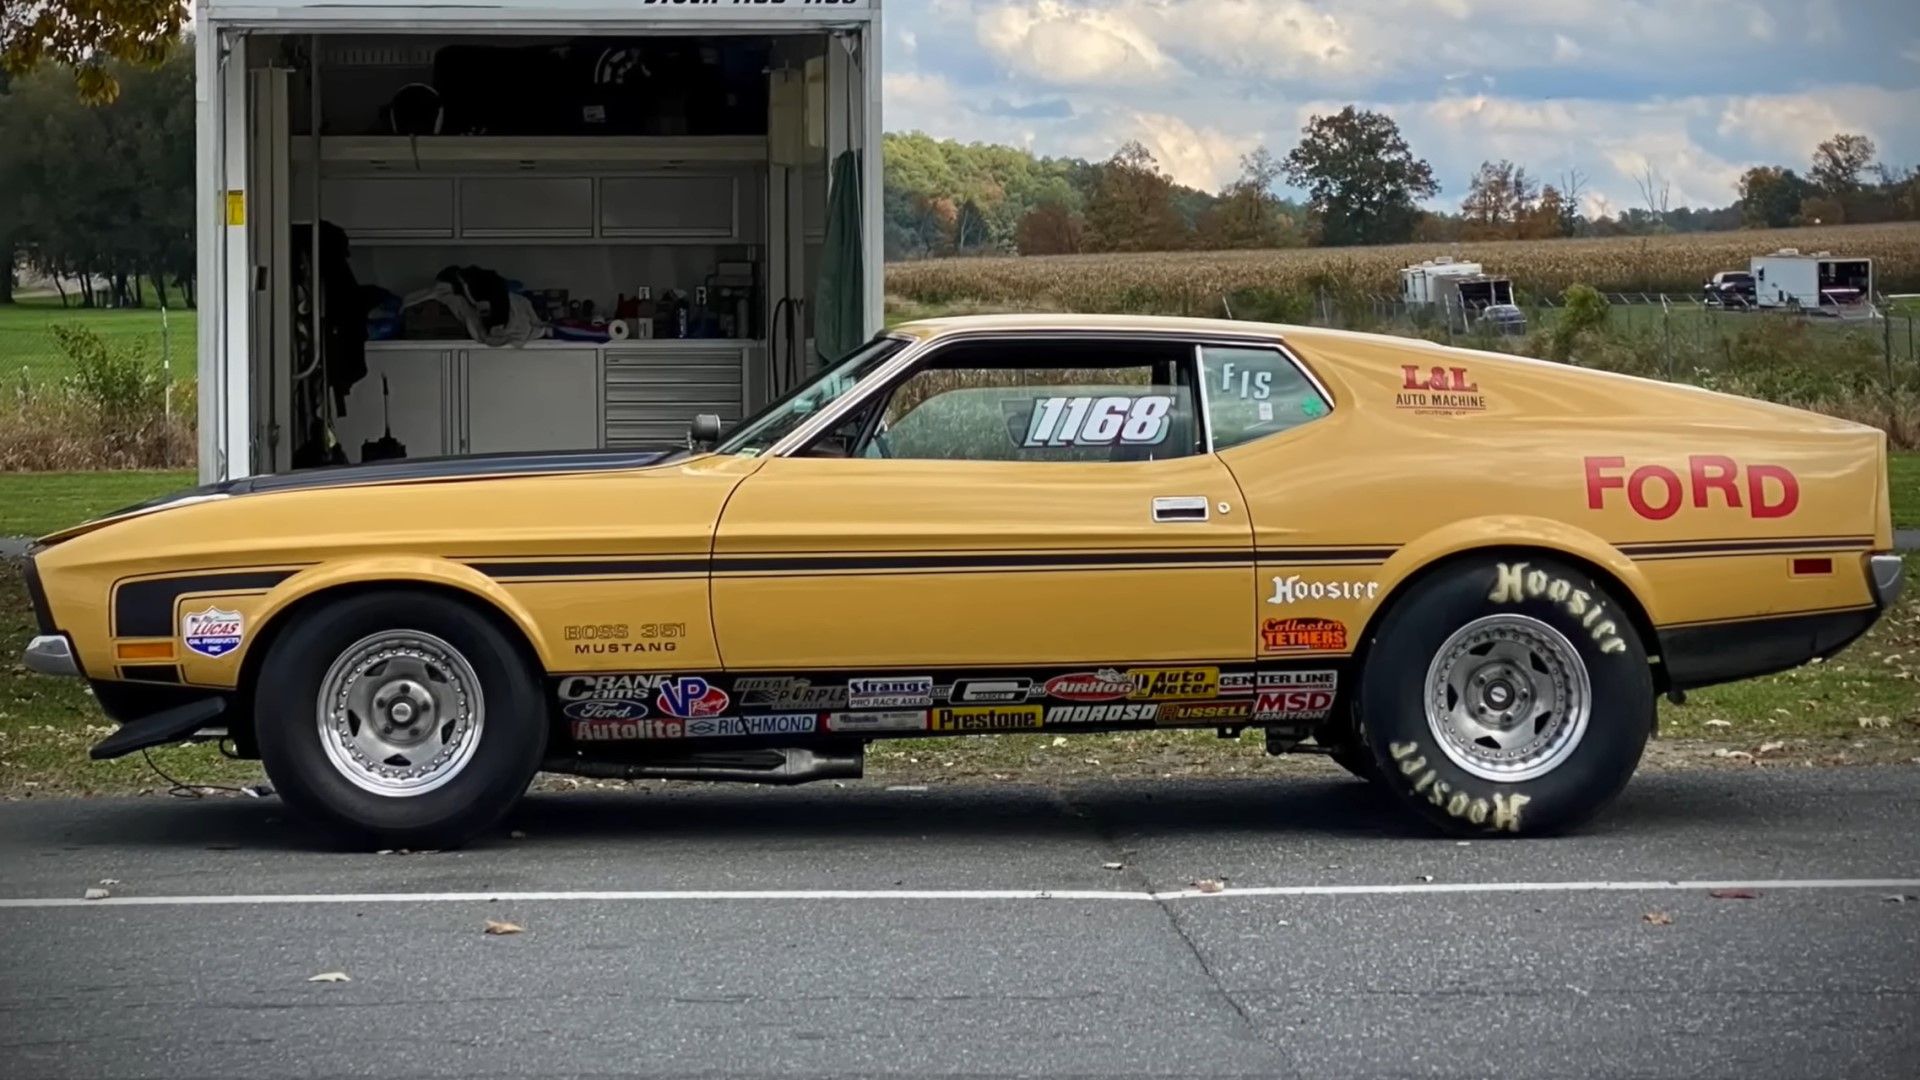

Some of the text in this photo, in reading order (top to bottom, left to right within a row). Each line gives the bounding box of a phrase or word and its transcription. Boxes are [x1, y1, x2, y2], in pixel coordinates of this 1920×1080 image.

[1222, 362, 1272, 400] FIS
[1401, 365, 1478, 392] L&L
[1396, 394, 1486, 408] AUTO MACHINE
[1024, 396, 1175, 447] 1168
[1584, 455, 1800, 520] FORD
[1267, 575, 1379, 604] Hoosier
[1488, 563, 1627, 654] Hoosier
[192, 622, 239, 635] LUCAS
[564, 623, 686, 640] BOSS 351
[1264, 631, 1344, 645] TETHERS
[574, 642, 677, 654] MUSTANG
[1155, 671, 1205, 683] Auto
[1296, 673, 1334, 682] LINE
[850, 681, 931, 693] Strange
[1149, 683, 1215, 696] Meter
[659, 676, 709, 718] VP
[1257, 692, 1332, 712] MSD
[580, 702, 632, 718] Ford
[1255, 711, 1325, 720] IGNITION
[940, 708, 1037, 730] Prestone
[576, 720, 682, 738] Autolite
[1389, 742, 1532, 832] Hoosier
